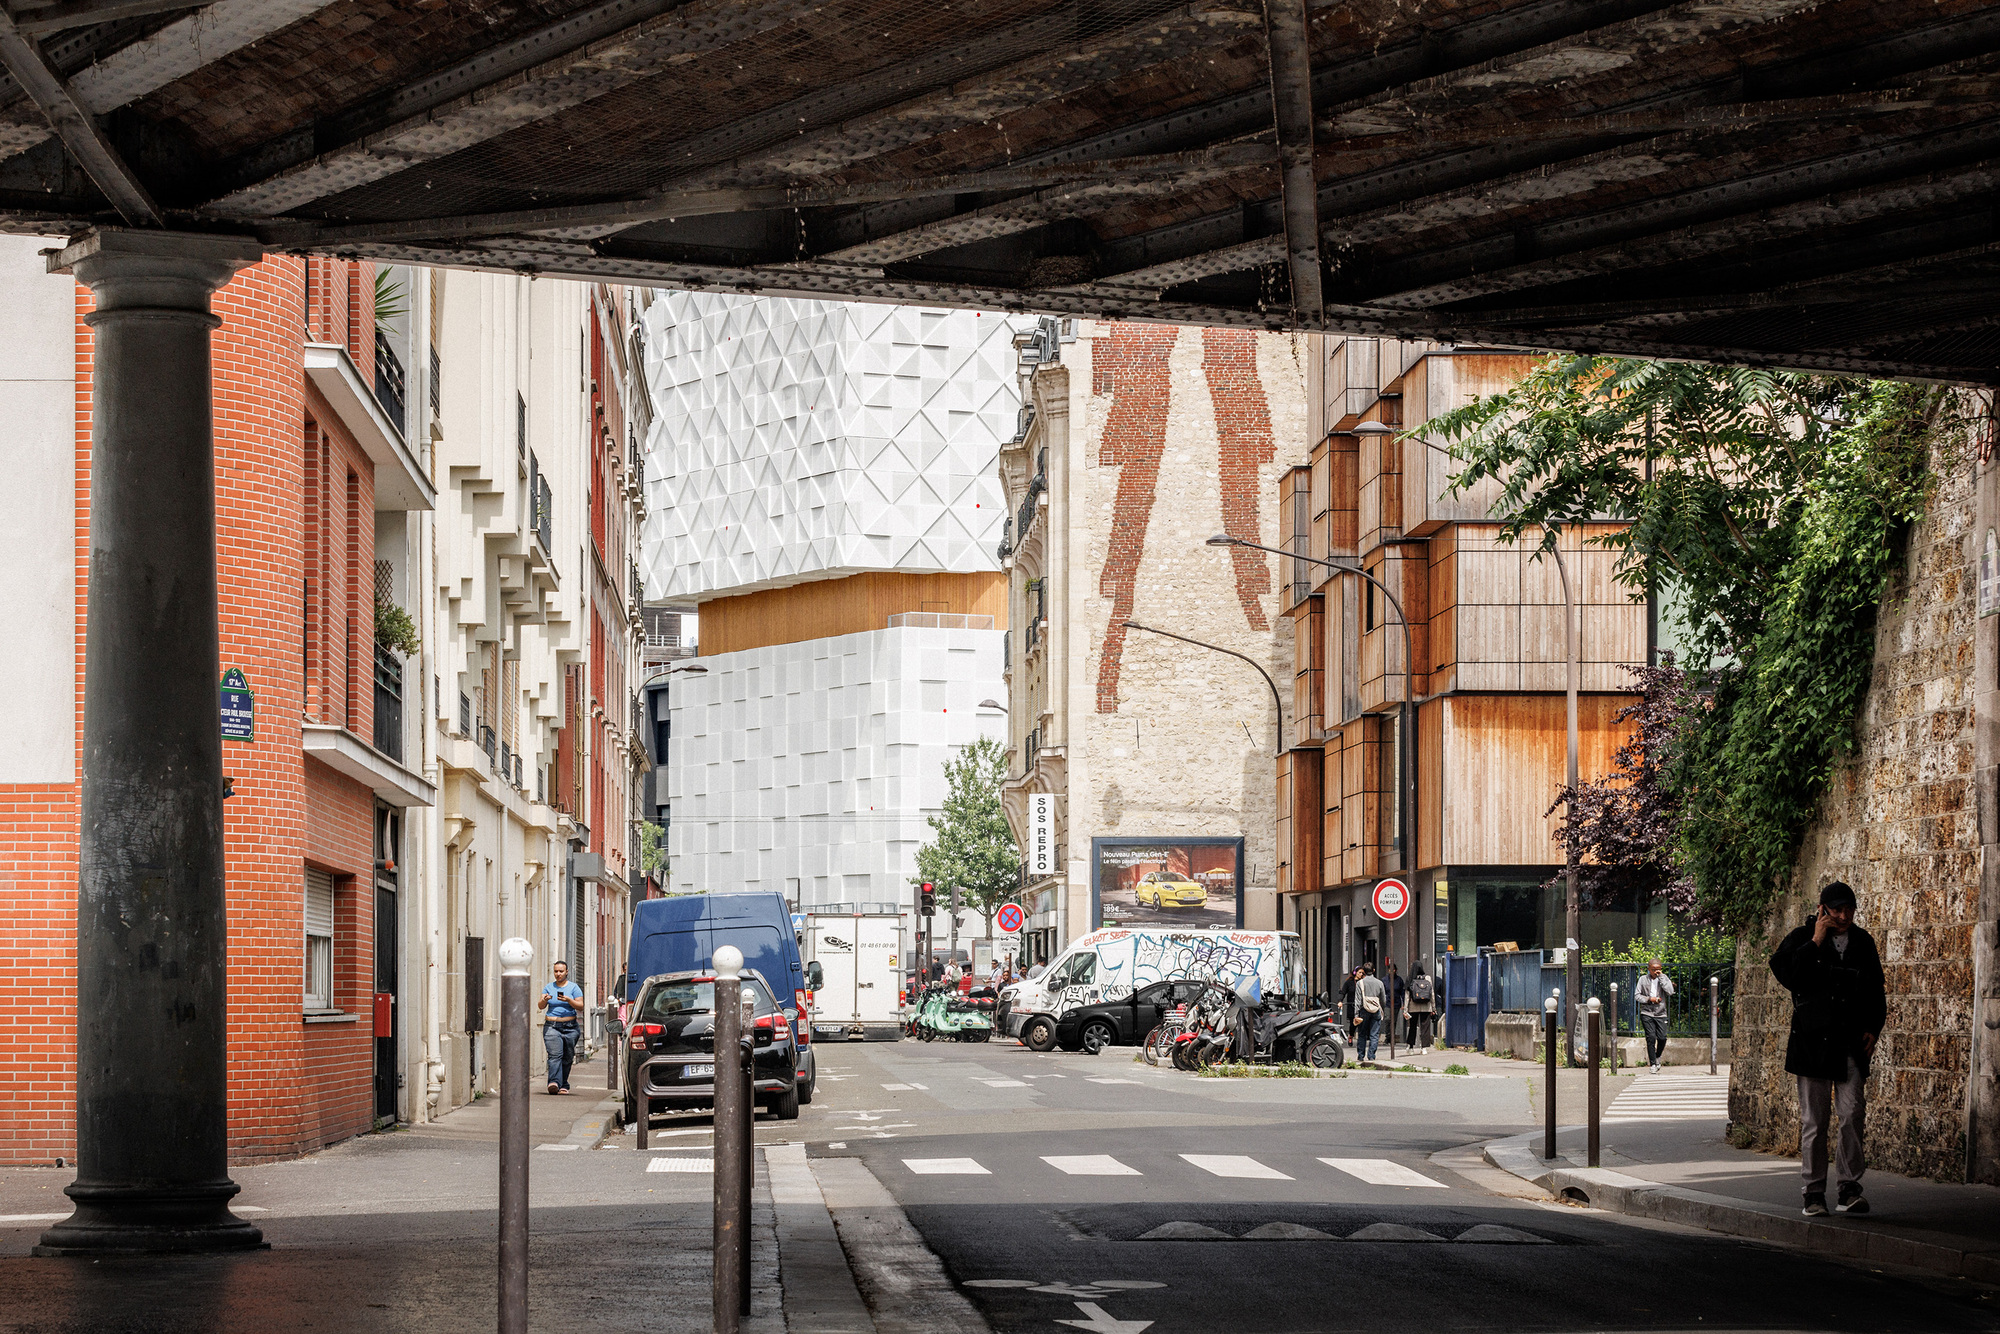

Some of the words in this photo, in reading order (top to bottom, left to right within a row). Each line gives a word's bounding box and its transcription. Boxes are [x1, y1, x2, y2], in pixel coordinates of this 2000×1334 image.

[1037, 798, 1046, 823] SOS
[1037, 828, 1046, 870] REPRO
[691, 1064, 714, 1074] EF-65
